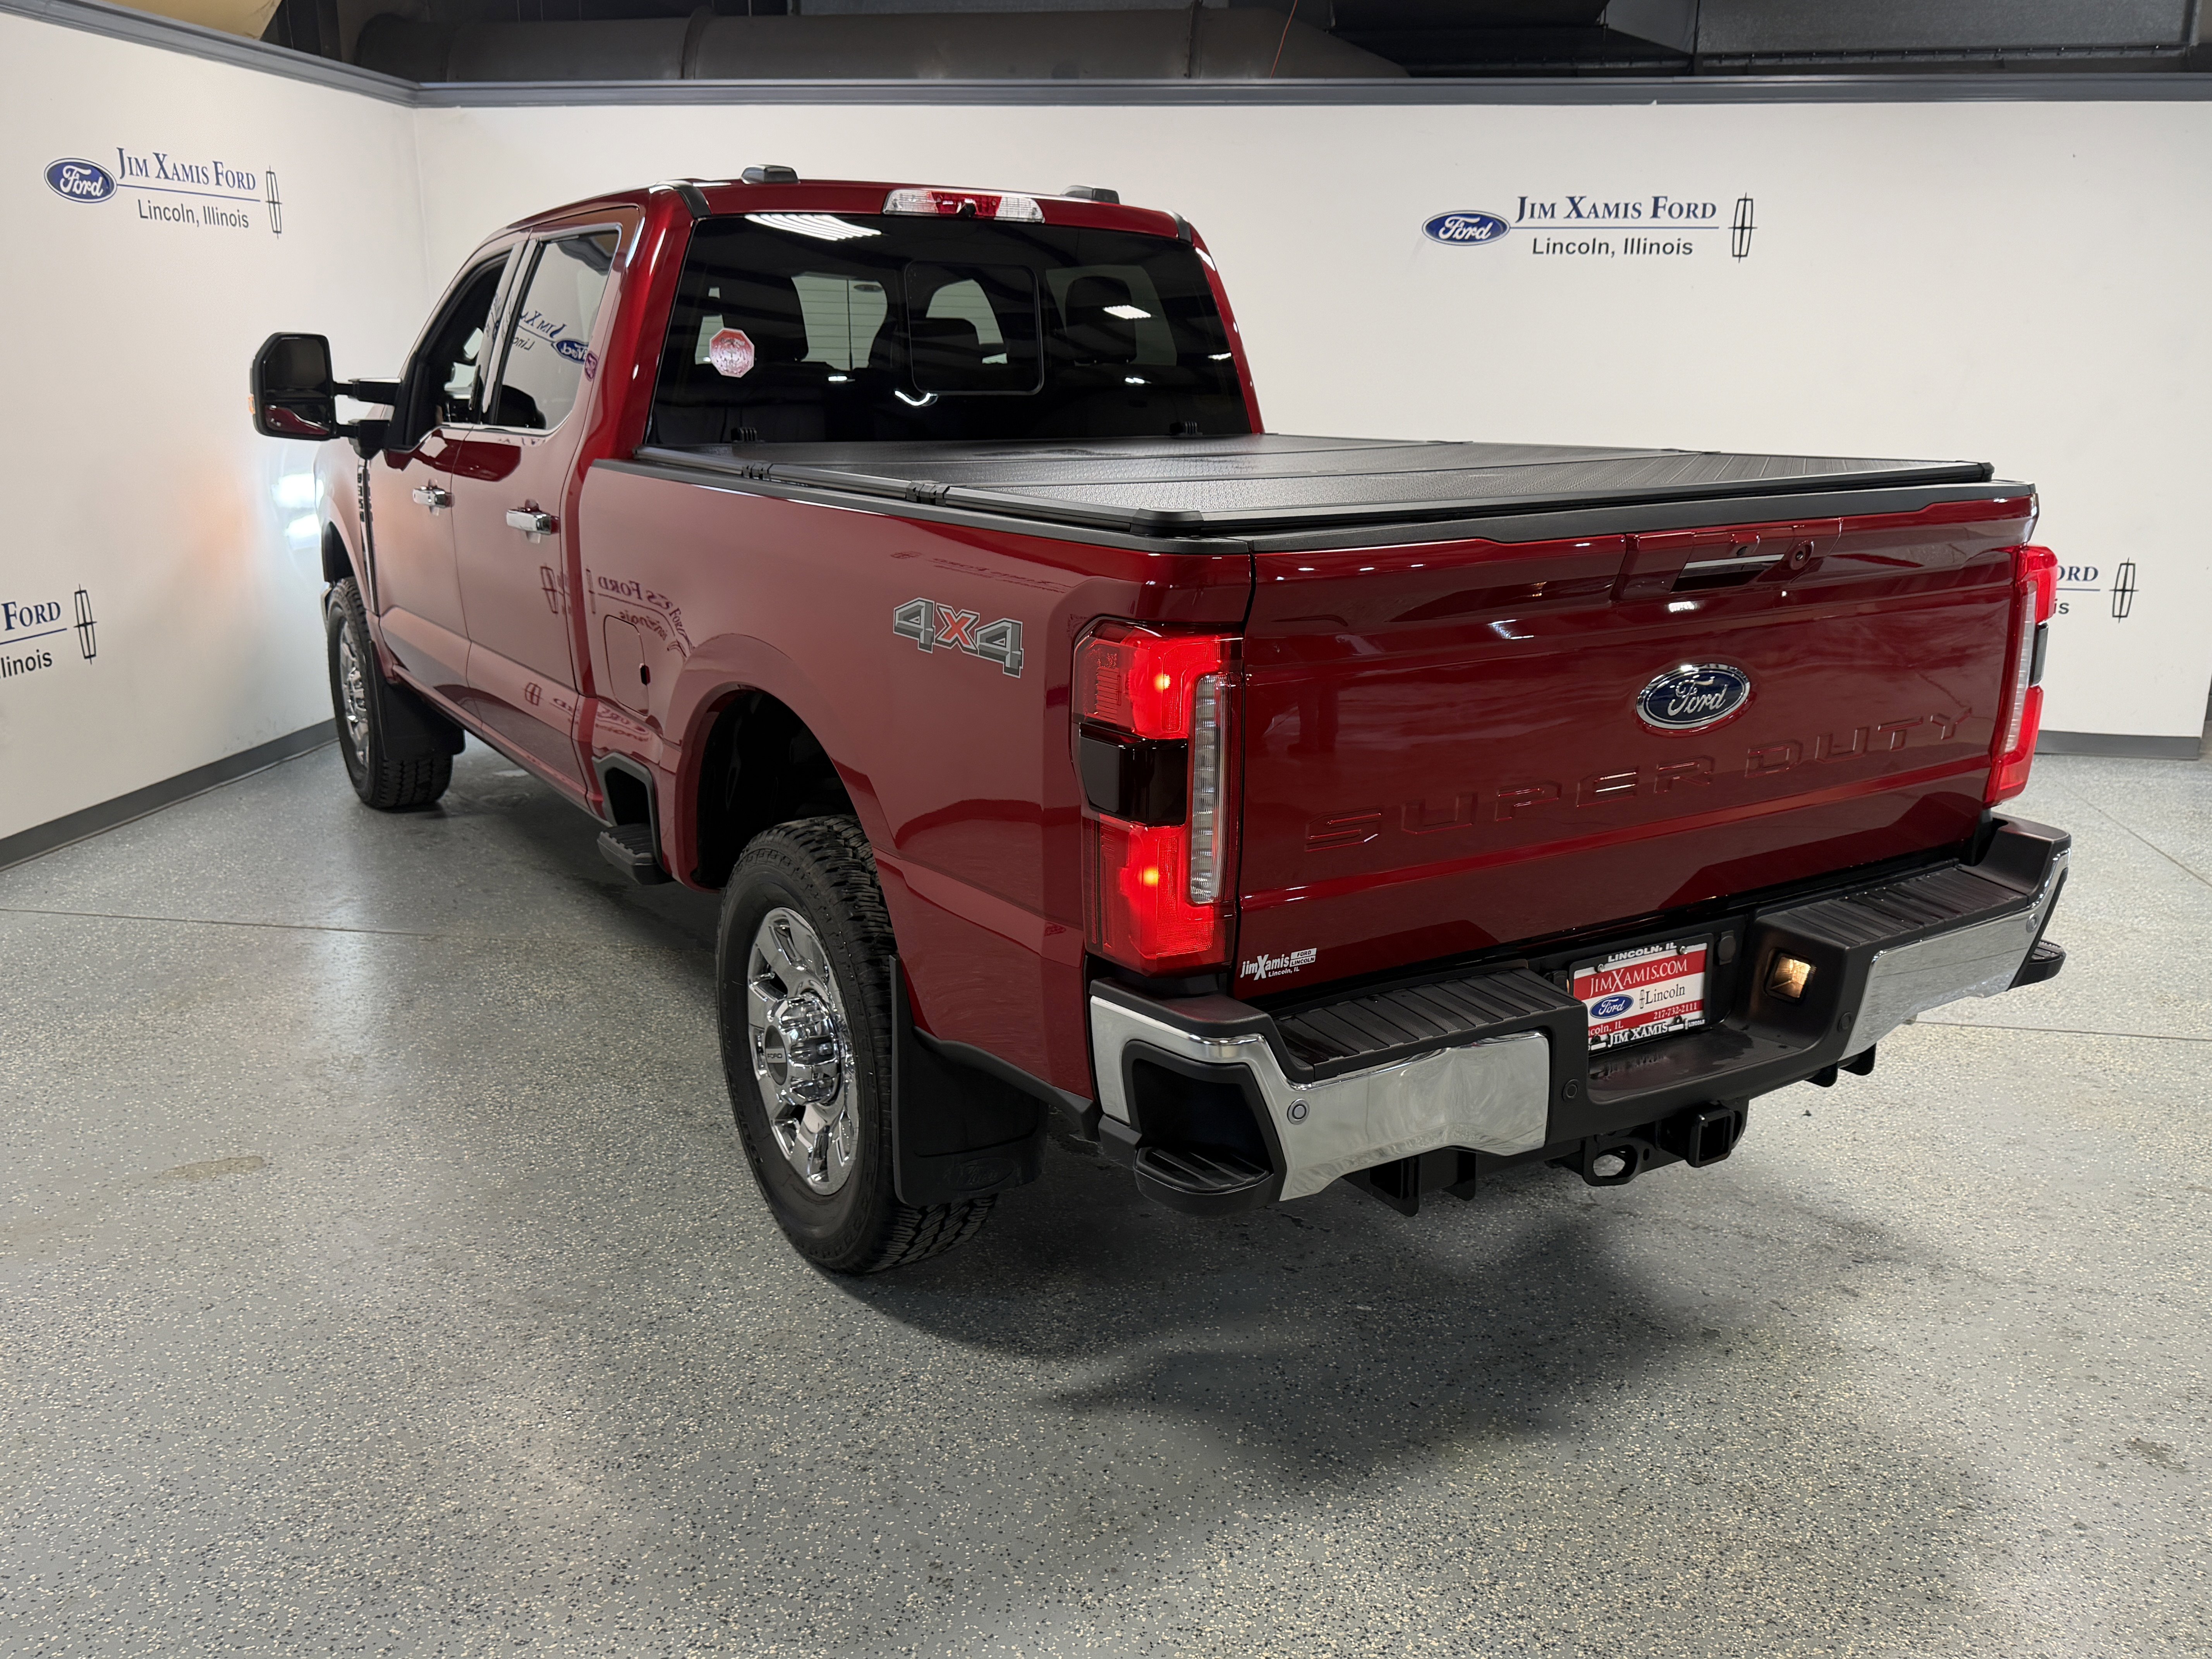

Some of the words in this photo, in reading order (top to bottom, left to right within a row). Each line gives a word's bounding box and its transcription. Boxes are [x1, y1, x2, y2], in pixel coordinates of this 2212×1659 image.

[62, 165, 103, 197] Ford
[116, 147, 149, 179] JIM
[153, 152, 209, 185] XAMIS
[212, 161, 256, 190] FORD
[138, 199, 199, 227] Lincoln,
[203, 205, 249, 228] Illinois
[1515, 196, 1557, 223] JIM
[1563, 196, 1642, 220] XAMIS
[1649, 196, 1716, 220] FORD
[1438, 216, 1491, 241] Ford
[1532, 238, 1616, 257] Lincoln,
[1623, 238, 1693, 255] Illinois
[2056, 565, 2098, 582] ORD
[1, 601, 60, 631] FORD
[0, 649, 52, 678] linois
[1667, 675, 1728, 716] Ford
[1305, 756, 1714, 852] SUPER
[1745, 706, 1972, 779] DUTY
[1291, 957, 1315, 965] LINCOLN
[1608, 945, 1663, 962] LINCOLN,
[1240, 954, 1290, 981] jimXamis
[1268, 968, 1292, 977] Lincoln,
[1589, 959, 1688, 997] JIMXAMIS.COM
[1598, 998, 1624, 1015] Ford
[1645, 984, 1685, 1005] Lincoln
[1654, 1002, 1697, 1020] 217-732-2111
[1588, 1024, 1611, 1036] coln,
[1615, 1020, 1623, 1029] IL
[1608, 1032, 1629, 1048] JIM
[1630, 1022, 1668, 1041] XAMIS
